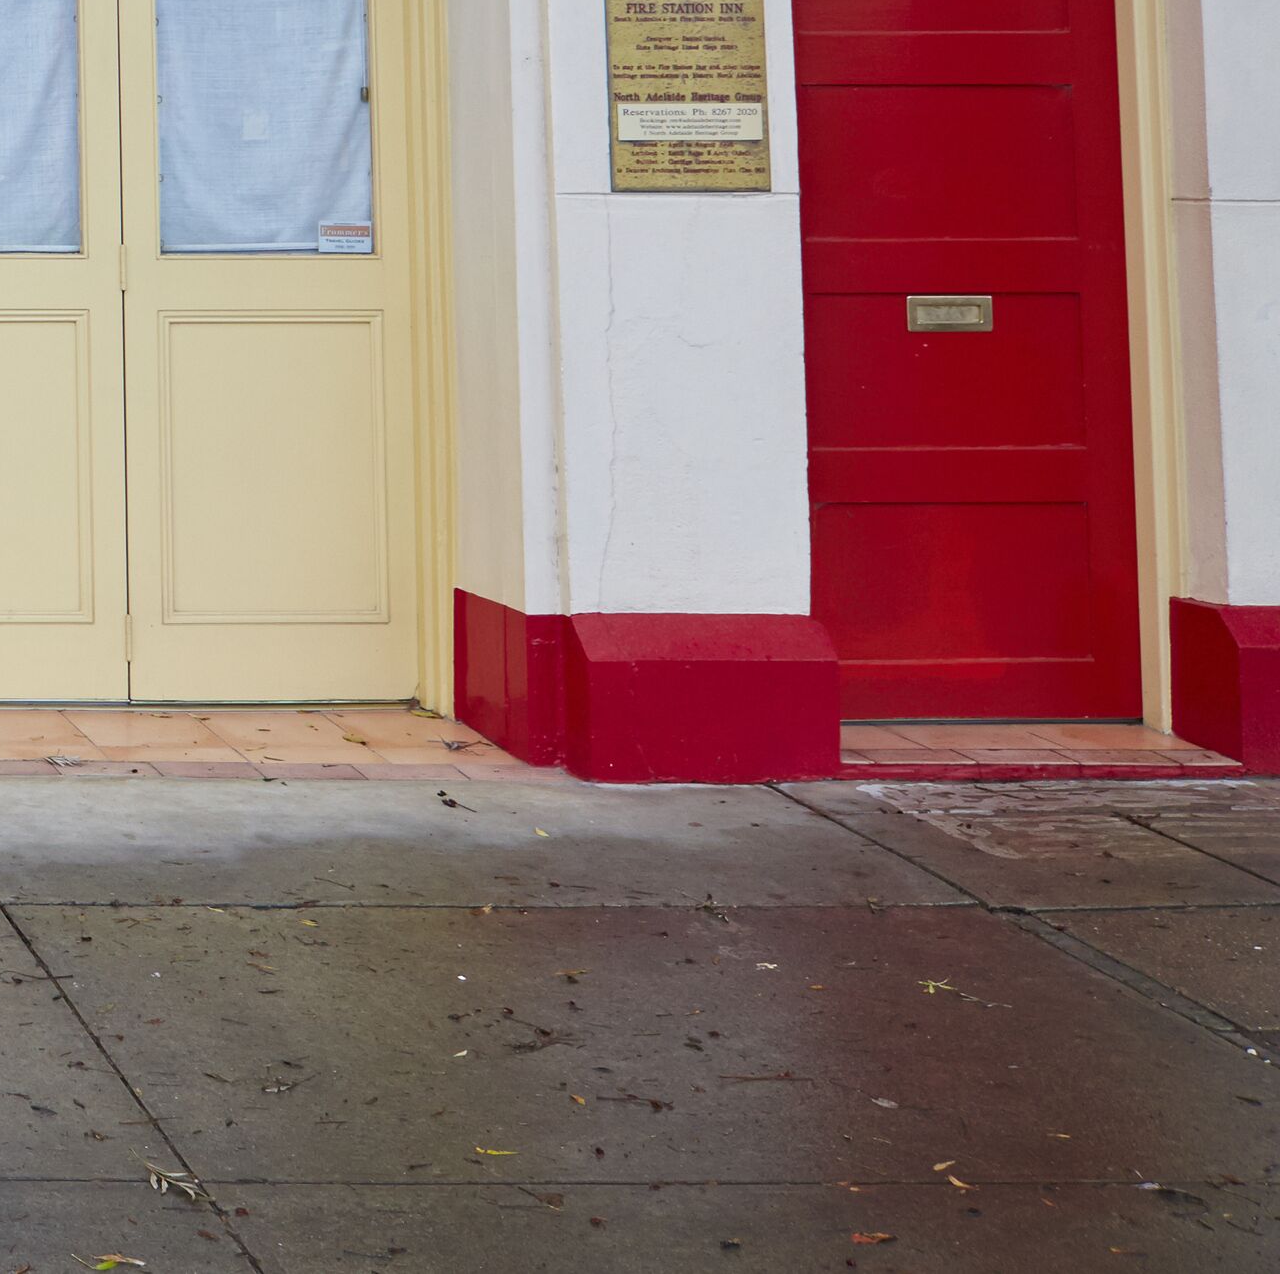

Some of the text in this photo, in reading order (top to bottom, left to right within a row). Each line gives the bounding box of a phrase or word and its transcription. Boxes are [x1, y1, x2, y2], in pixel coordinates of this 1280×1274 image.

[626, 3, 744, 14] FIRE STATION INN
[614, 92, 762, 103] North Adelaide Heritage Group
[711, 108, 732, 116] 8267
[736, 108, 758, 116] 2020
